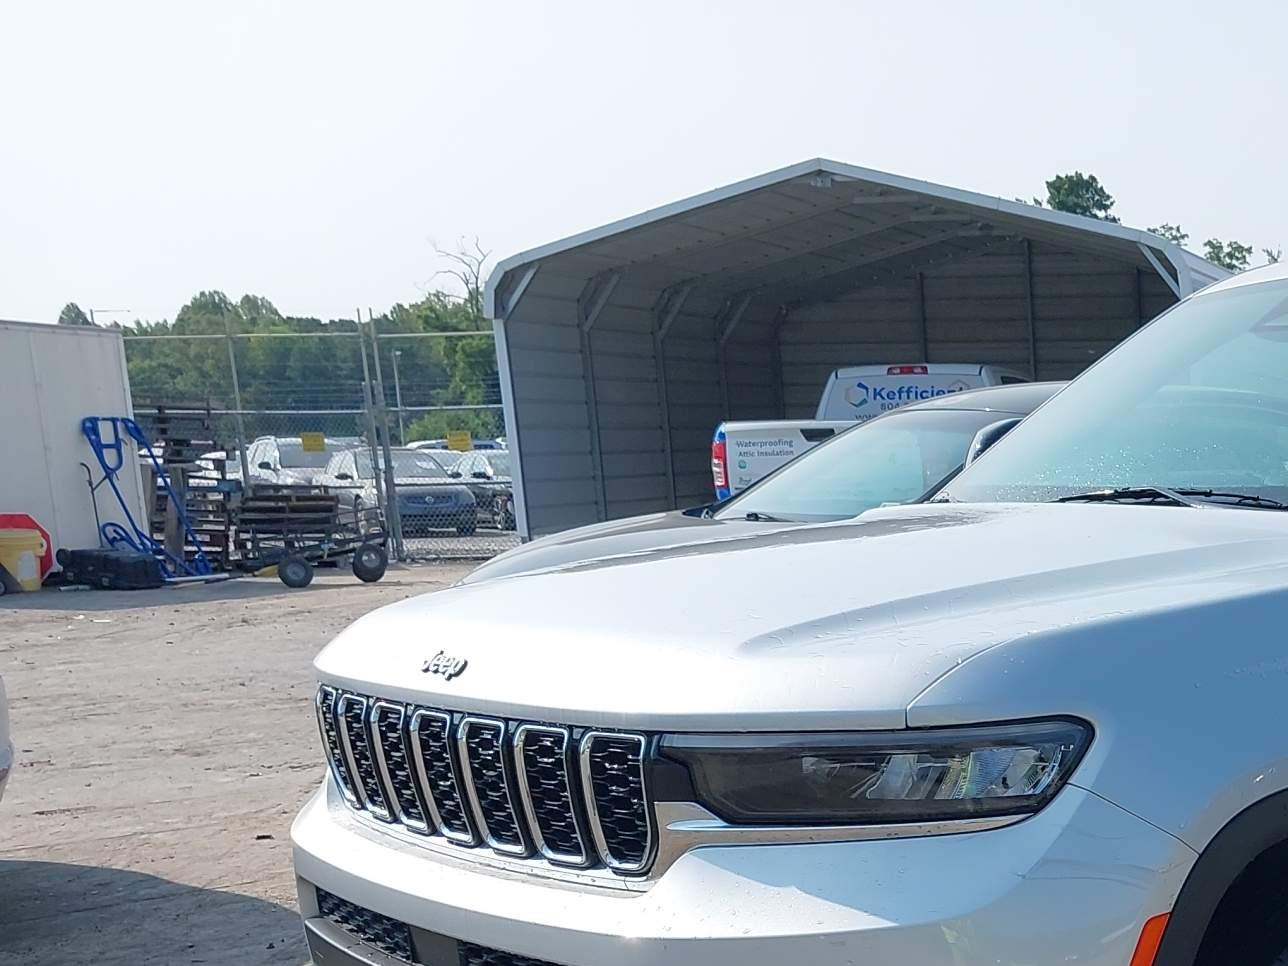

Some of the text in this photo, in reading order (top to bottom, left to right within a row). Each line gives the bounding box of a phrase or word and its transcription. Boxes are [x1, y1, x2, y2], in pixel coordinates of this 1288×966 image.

[873, 385, 963, 401] Kefficie
[736, 440, 794, 449] Waterproofing
[739, 449, 794, 458] Attic Insulation
[421, 650, 468, 682] Jeep
